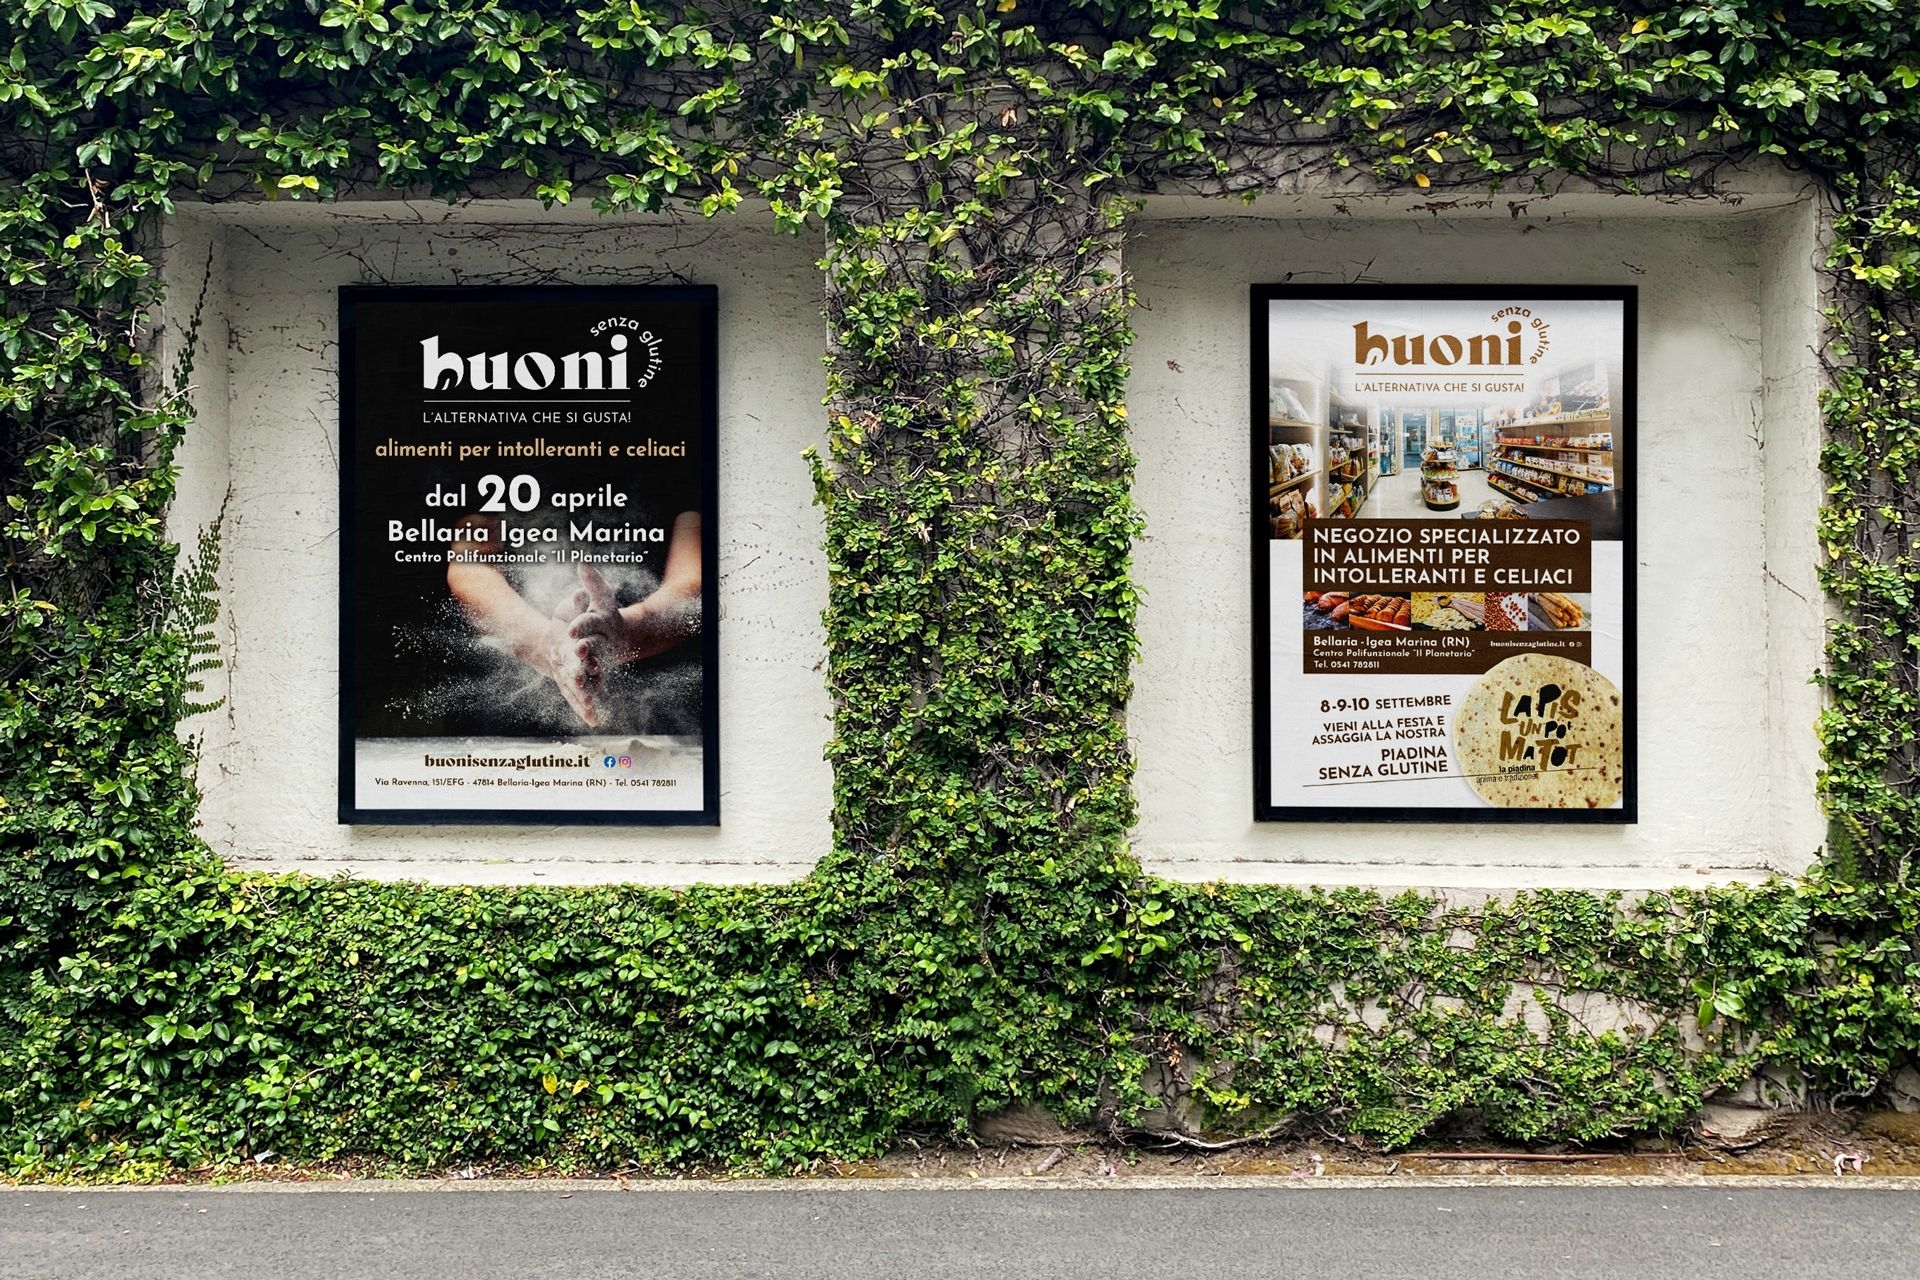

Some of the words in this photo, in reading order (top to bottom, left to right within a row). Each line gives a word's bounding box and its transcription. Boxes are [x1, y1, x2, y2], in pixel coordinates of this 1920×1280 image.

[1353, 320, 1524, 365] buoni
[1491, 306, 1531, 322] senza
[1530, 318, 1550, 364] glutine
[590, 316, 639, 337] senza
[638, 330, 663, 388] glutine
[420, 333, 631, 391] buoni
[1355, 382, 1440, 393] L'ALTERNATIVA
[1444, 382, 1468, 393] CHE
[1472, 382, 1481, 393] SI
[1485, 382, 1524, 393] GUSTA!
[423, 411, 527, 424] L'ALTERNATIVA
[532, 411, 562, 424] CHE
[566, 411, 578, 424] SI
[583, 411, 631, 424] GUSTA!
[375, 438, 452, 457] alimenti
[459, 444, 490, 461] per
[498, 438, 602, 457] intolleranti
[608, 444, 621, 457] e
[626, 438, 686, 457] celiaci
[425, 484, 466, 507] dal
[477, 474, 540, 512] 20
[551, 484, 628, 512] aprile
[388, 518, 489, 542] Bellaria
[500, 520, 558, 548] Igea
[569, 520, 665, 542] Marina
[1313, 528, 1412, 544] NEGOZIO
[1419, 528, 1580, 545] SPECIALIZZATO
[394, 550, 442, 563] Centro
[447, 550, 547, 563] Polifunzionale
[571, 550, 648, 563] Planetario"
[1313, 548, 1336, 564] IN
[1343, 548, 1443, 564] ALIMENTI
[1452, 548, 1490, 564] PER
[1313, 568, 1466, 584] INTOLLERANTI
[1474, 568, 1485, 584] E
[1493, 568, 1573, 585] CELIACI
[1313, 635, 1358, 646] Bellaria
[1396, 636, 1438, 647] Marina
[1442, 636, 1470, 648] (RN)
[1490, 640, 1566, 648] buonisenzaglutine.it
[1313, 648, 1344, 657] Centro
[1346, 648, 1410, 657] Polifunzionale
[1314, 660, 1328, 668] Tel.
[1331, 660, 1350, 669] 0541
[1353, 660, 1379, 669] 782811
[1320, 697, 1370, 713] 8-9-10
[1375, 695, 1451, 709] SETTEMBRE
[1323, 721, 1357, 732] VIENI
[1362, 720, 1393, 731] ALLA
[1397, 717, 1433, 728] FESTA
[1437, 715, 1445, 725] E
[1519, 719, 1542, 736] UN
[1312, 732, 1372, 745] ASSAGGIA
[1376, 731, 1392, 741] LA
[1396, 727, 1446, 740] NOSTRA
[1381, 745, 1447, 761] PIADINA
[424, 754, 590, 771] buonisenzaglutine.it
[1319, 765, 1373, 780] SENZA
[1378, 760, 1448, 776] GLUTINE
[1499, 765, 1506, 773] la
[1508, 764, 1536, 774] piadina
[375, 778, 389, 787] Via
[392, 778, 430, 787] Ravenna,
[432, 778, 464, 787] 151/EFG
[472, 778, 495, 787] 47814
[497, 778, 550, 788] Bellaria-Igea
[553, 779, 583, 787] Marina
[586, 779, 607, 788] (RN)
[615, 779, 628, 787] Tel.
[630, 779, 649, 787] 0541
[651, 779, 677, 787] 782811
